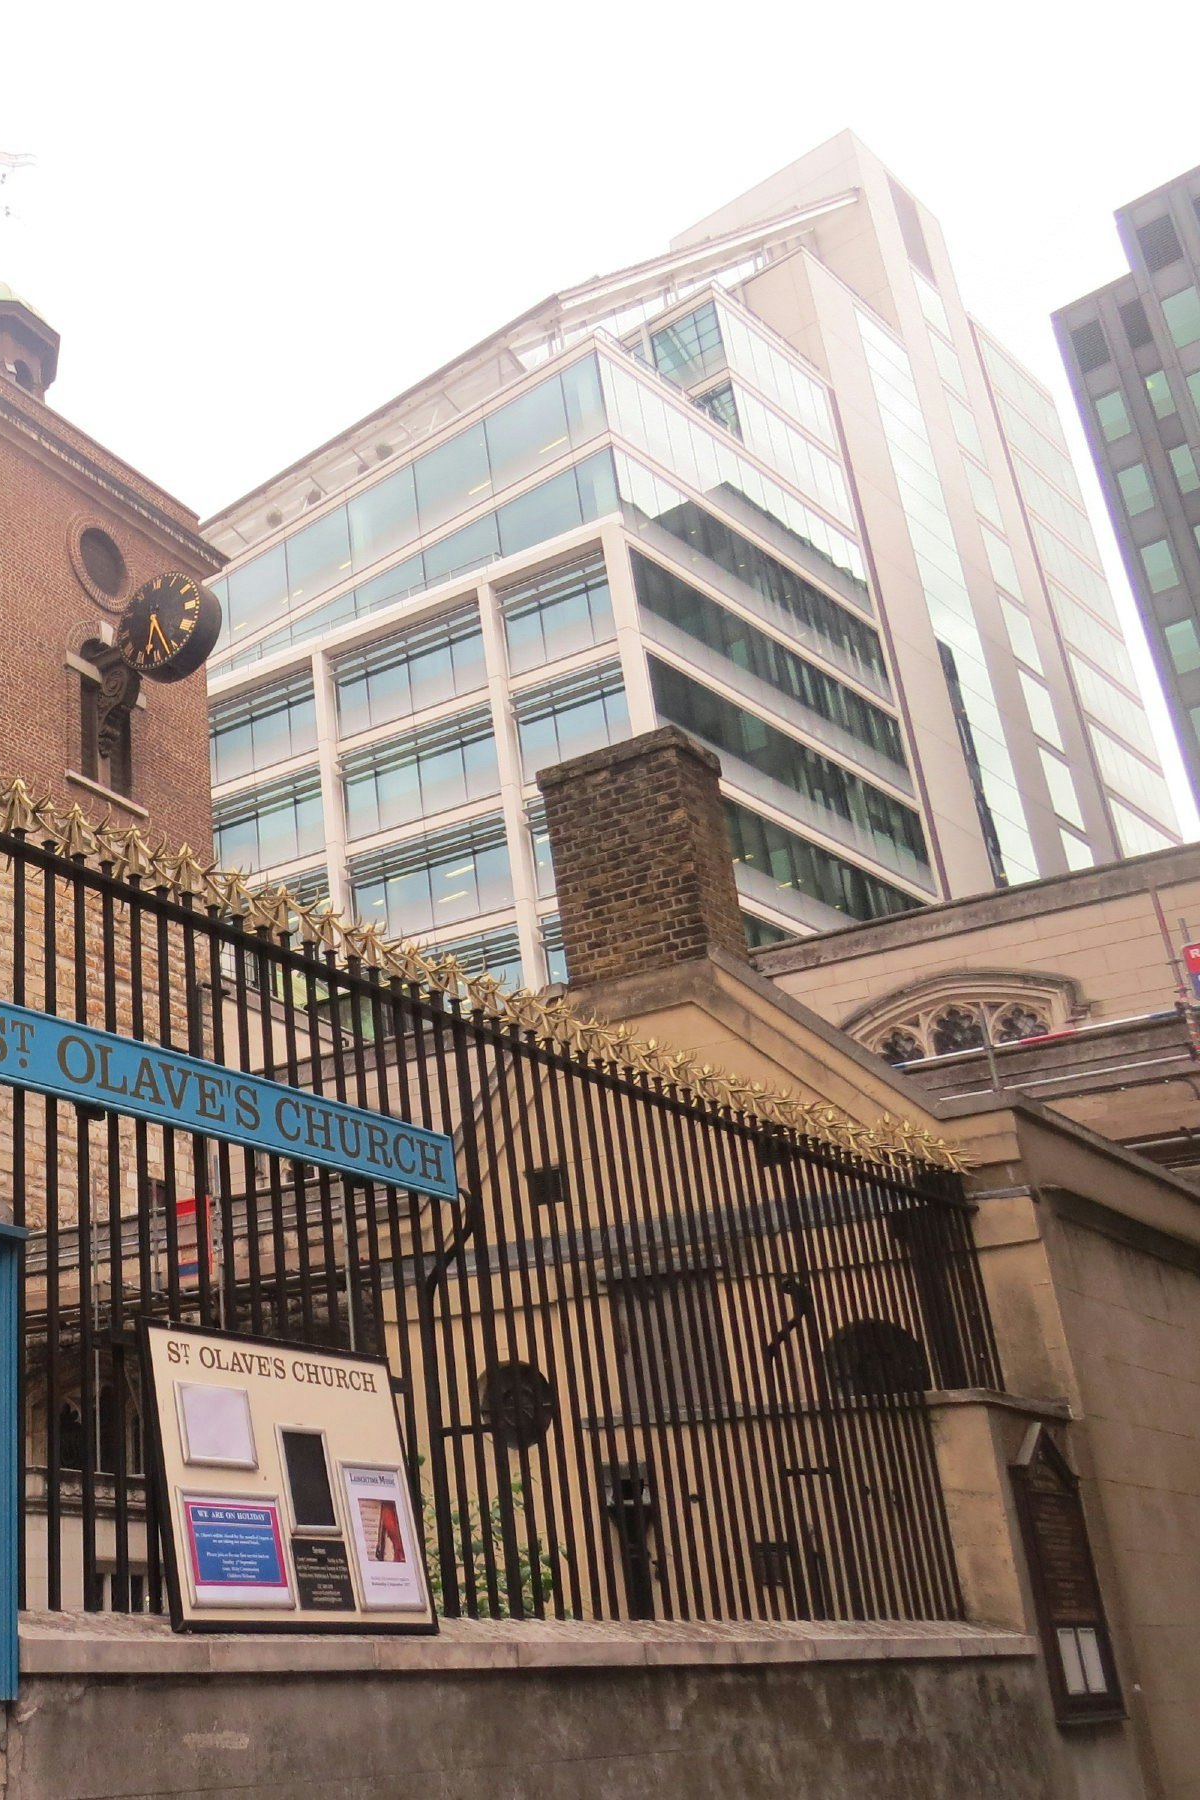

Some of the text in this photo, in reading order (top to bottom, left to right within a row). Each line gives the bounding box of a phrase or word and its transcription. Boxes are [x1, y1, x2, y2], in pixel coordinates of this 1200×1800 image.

[57, 1034, 260, 1131] OLAVE'S
[275, 1097, 447, 1184] CHURCH
[198, 1346, 286, 1379] OLAVE'S
[291, 1360, 378, 1393] CHURCH
[197, 1509, 266, 1521] WE ARE ON HOLIDAY
